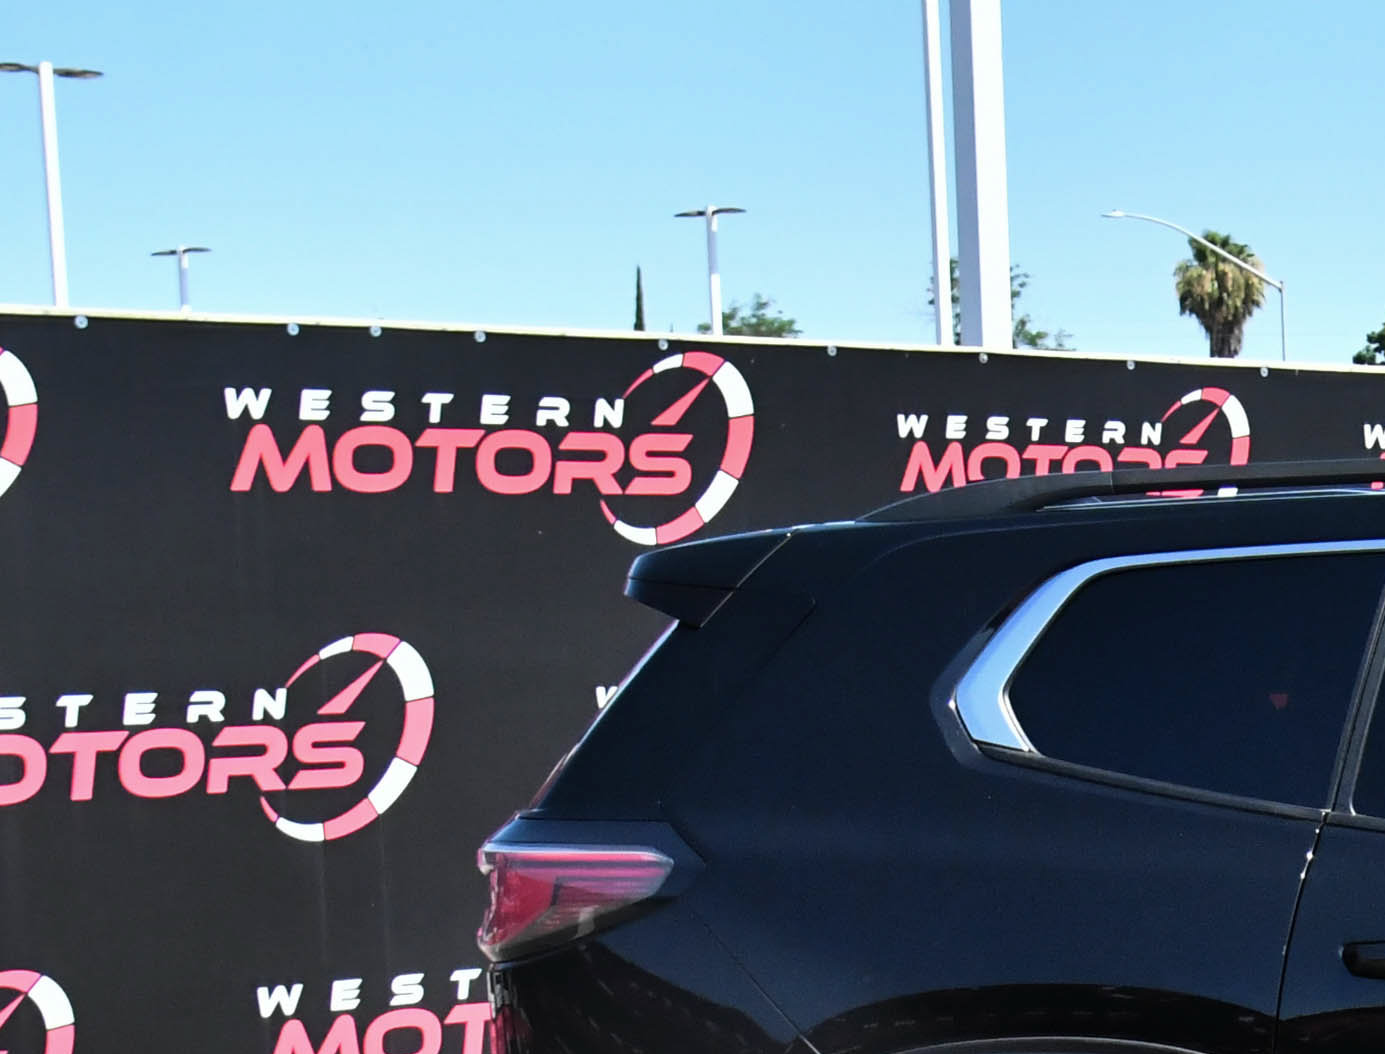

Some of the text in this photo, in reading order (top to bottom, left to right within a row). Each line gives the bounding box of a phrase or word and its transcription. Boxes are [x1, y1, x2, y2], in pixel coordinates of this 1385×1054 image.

[223, 387, 625, 428] WESTERN
[896, 414, 1163, 445] WESTERN
[229, 423, 694, 496] MOTORS
[256, 967, 483, 1019] WEST
